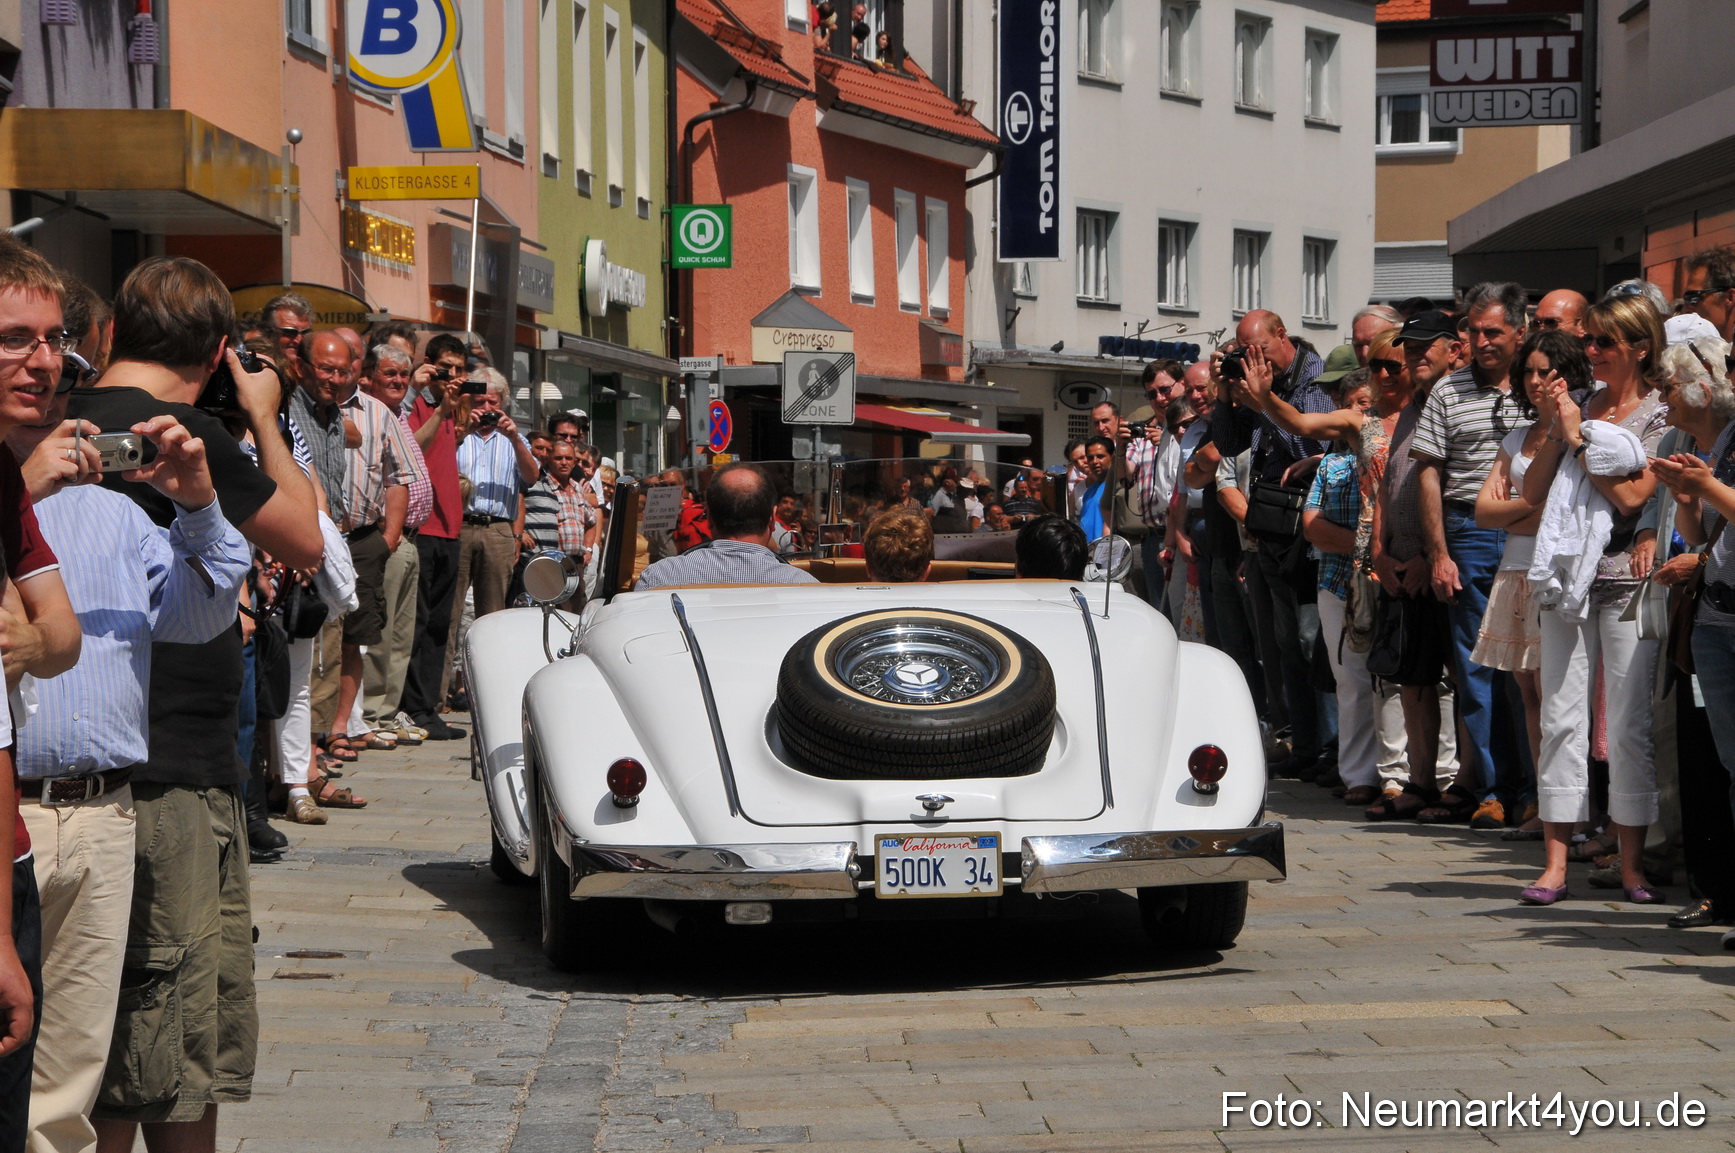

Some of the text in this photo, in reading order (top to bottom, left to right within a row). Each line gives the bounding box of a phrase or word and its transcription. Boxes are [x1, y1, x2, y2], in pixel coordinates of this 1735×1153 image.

[360, 0, 418, 55] B
[1437, 35, 1576, 82] WITT
[1039, 0, 1056, 234] TOM TAILOR
[1434, 86, 1577, 123] WEIDEN
[355, 175, 471, 190] KLOSTERGASSE 4
[690, 218, 714, 245] Q
[678, 256, 700, 264] QUICK
[773, 329, 835, 350] Creppresso
[801, 405, 836, 417] ZONE
[882, 839, 899, 848] AUG
[903, 837, 971, 855] California
[886, 857, 993, 887] 500K 34
